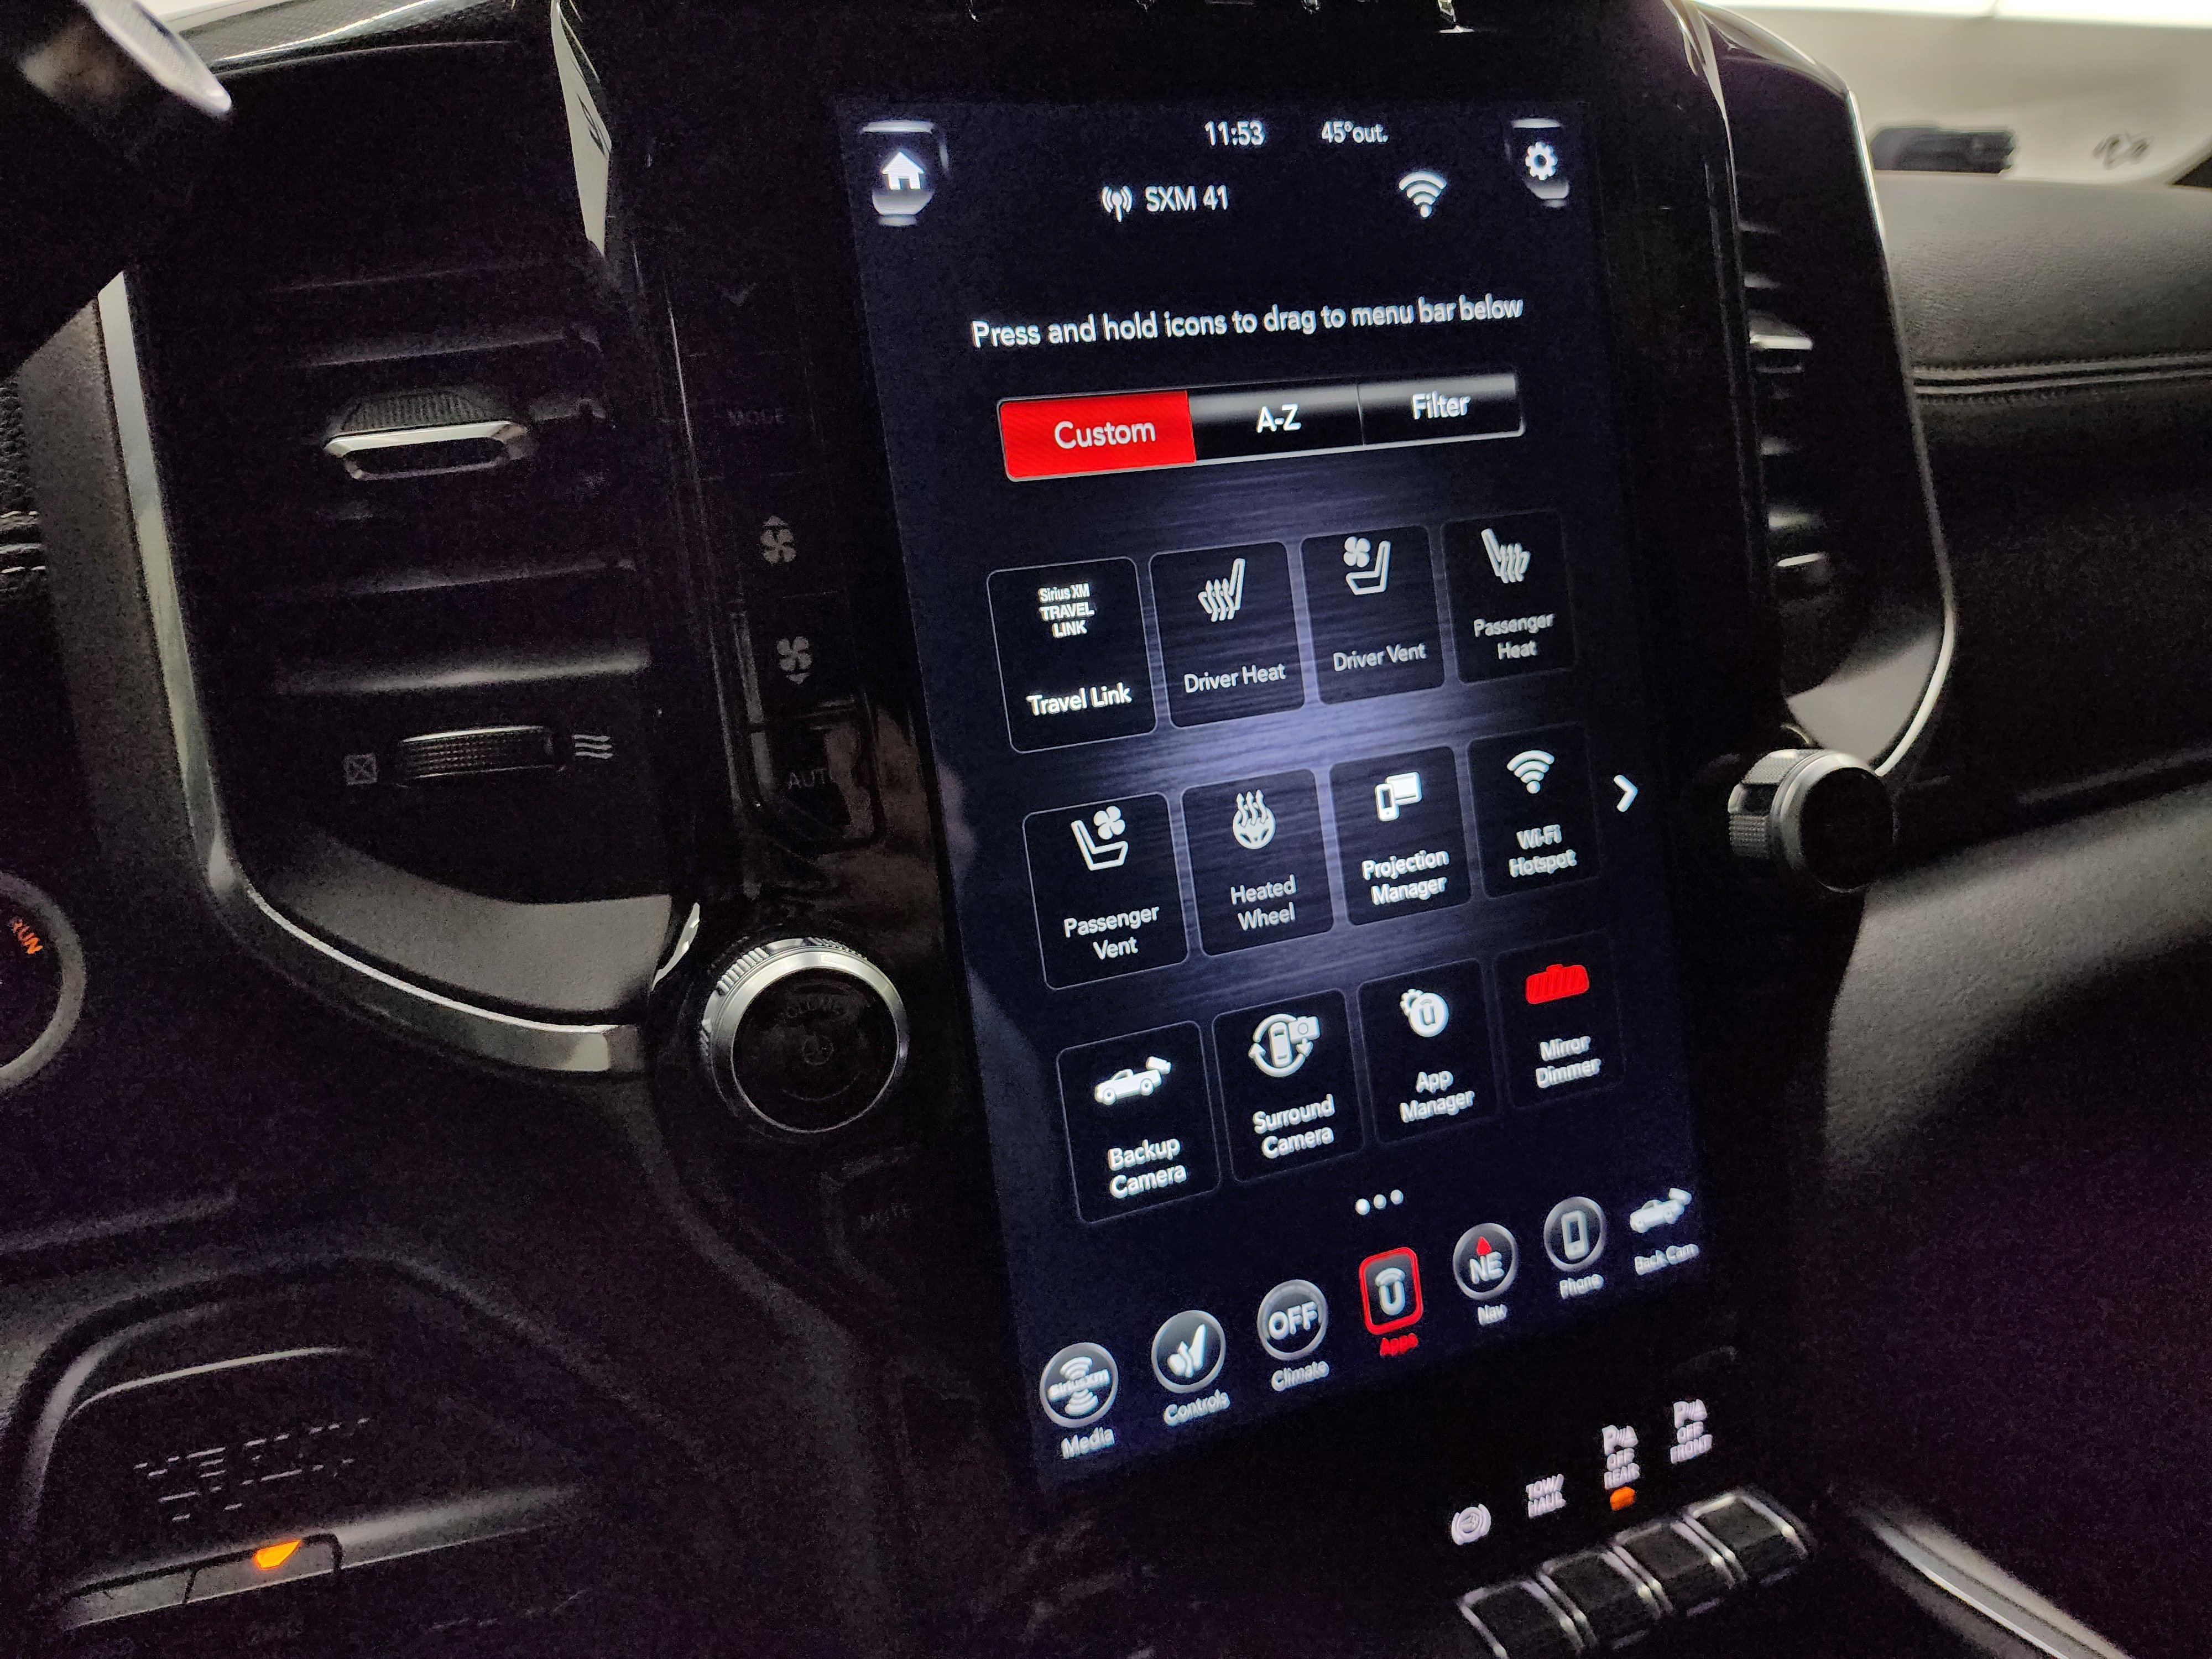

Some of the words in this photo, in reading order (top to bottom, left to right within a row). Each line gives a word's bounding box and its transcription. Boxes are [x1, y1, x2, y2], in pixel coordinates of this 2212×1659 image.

[1204, 119, 1266, 146] 11:53
[1144, 185, 1197, 212] SXM
[1203, 185, 1228, 211] 41
[971, 320, 1041, 348] Press
[1047, 313, 1097, 344] and
[1102, 310, 1159, 341] hold
[1164, 311, 1228, 338] icons
[1231, 310, 1258, 333] to
[1263, 304, 1317, 335] drag
[1320, 305, 1347, 329] to
[1351, 305, 1415, 327] menu
[1417, 296, 1457, 324] bar
[1458, 293, 1524, 321] below
[1256, 403, 1301, 433] A-Z
[1412, 390, 1471, 420] Filter
[1055, 421, 1156, 449] Custom
[1039, 601, 1095, 621] TRAVEL
[1473, 613, 1554, 638] Passenger
[1052, 619, 1088, 639] LINK
[1333, 650, 1385, 672] Driver
[1386, 643, 1427, 663] Vent
[1497, 640, 1537, 660] Heat
[1184, 671, 1239, 693] Driver
[1241, 663, 1287, 685] Heat
[1026, 687, 1088, 716] Travel
[1090, 682, 1133, 708] Link
[1516, 824, 1562, 850] Wi-Fi
[1361, 849, 1449, 880] Projection
[1509, 849, 1578, 878] Hotspot
[1230, 874, 1297, 905] Heated
[1371, 877, 1447, 905] Manager
[1063, 906, 1160, 938] Passenger
[1237, 901, 1296, 931] Wheel
[1092, 936, 1139, 960] Vent
[1540, 1036, 1591, 1062] Mirror
[1415, 1071, 1454, 1094] App
[1535, 1058, 1602, 1089] Dimmer
[1253, 1093, 1335, 1134] Surround
[1400, 1091, 1475, 1123] Manager
[1107, 1138, 1181, 1171] Backup
[1261, 1126, 1334, 1159] Camera
[1109, 1165, 1187, 1199] Camera
[1469, 1251, 1505, 1284] NE
[1634, 1249, 1669, 1276] Back
[1666, 1243, 1699, 1265] Cam
[1559, 1274, 1605, 1300] Phone
[1269, 1301, 1318, 1340] OFF
[1477, 1303, 1508, 1326] Nav
[1380, 1332, 1418, 1356] Apps
[1271, 1360, 1330, 1392] Climate
[1163, 1389, 1230, 1427] Controls
[1061, 1426, 1117, 1459] Media
[1677, 1421, 1704, 1444] OFF
[1606, 1448, 1635, 1472] OFF
[1528, 1491, 1566, 1518] HAUL
